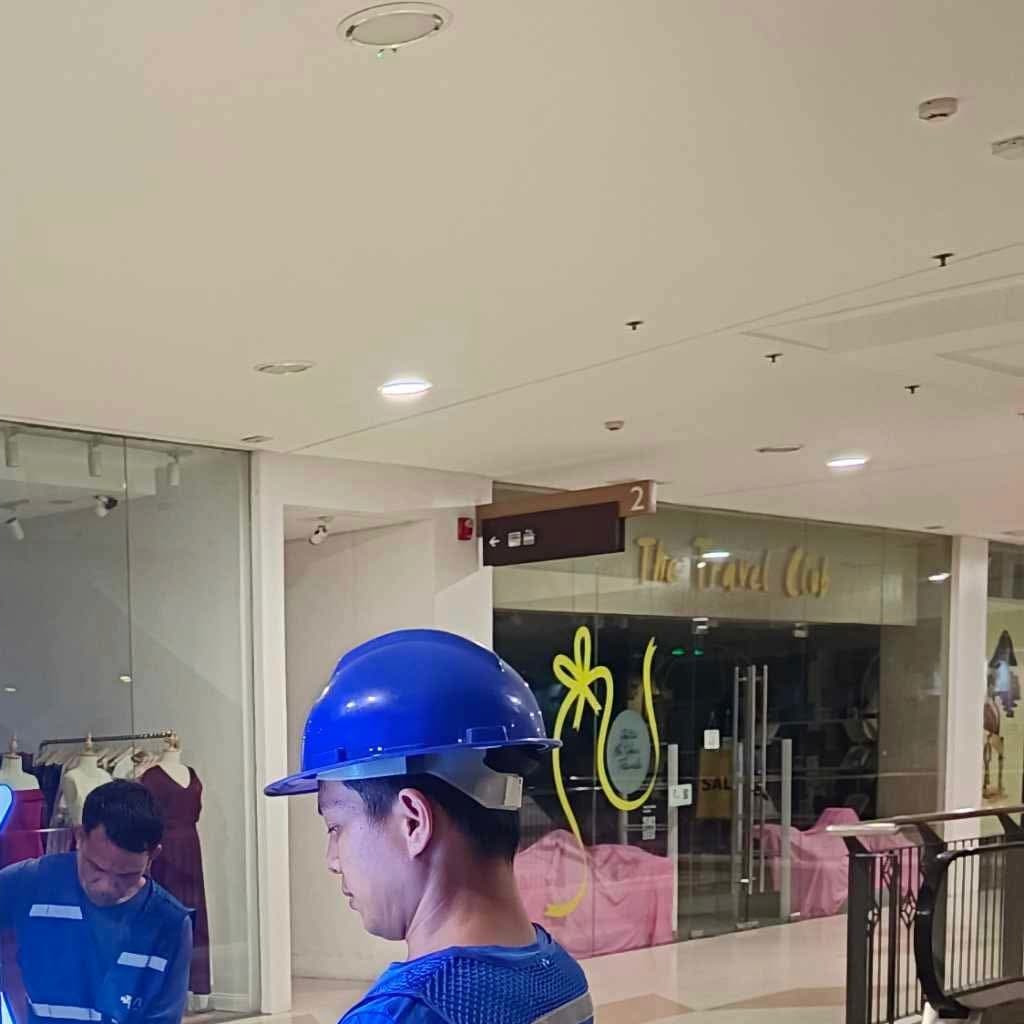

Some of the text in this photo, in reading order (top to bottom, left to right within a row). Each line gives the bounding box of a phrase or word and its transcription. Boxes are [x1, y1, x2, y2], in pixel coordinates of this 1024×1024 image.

[629, 486, 645, 511] 2
[636, 537, 677, 583] The
[693, 537, 769, 592] Travel
